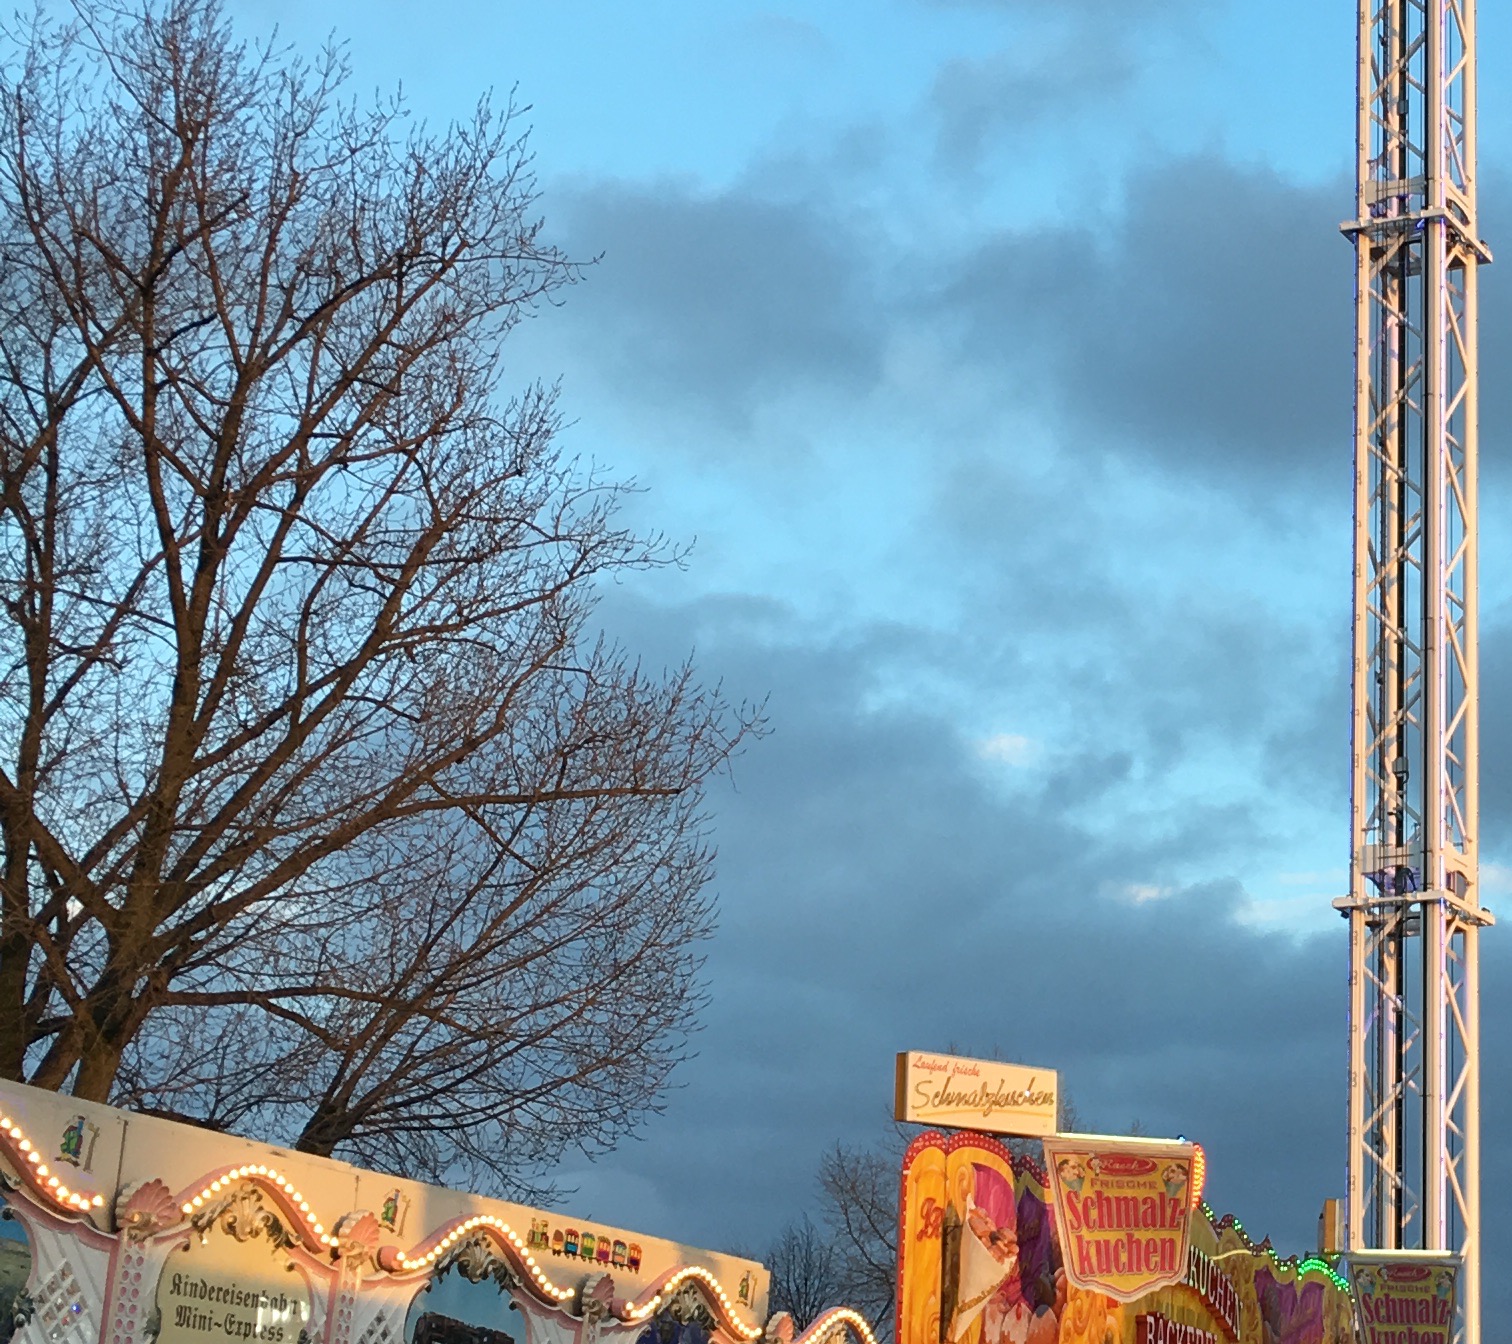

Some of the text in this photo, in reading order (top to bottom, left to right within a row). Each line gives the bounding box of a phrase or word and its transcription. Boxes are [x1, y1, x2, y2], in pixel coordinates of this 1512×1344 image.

[911, 1076, 1054, 1118] Schmalzkuchen
[1090, 1177, 1158, 1190] FRISCHE
[1066, 1189, 1187, 1232] Schmalz-
[1076, 1232, 1176, 1277] kuchen
[169, 1272, 298, 1316] Kindereisenbahn
[1180, 1244, 1244, 1342] KUCHEN
[1362, 1292, 1452, 1325] Schmalz-
